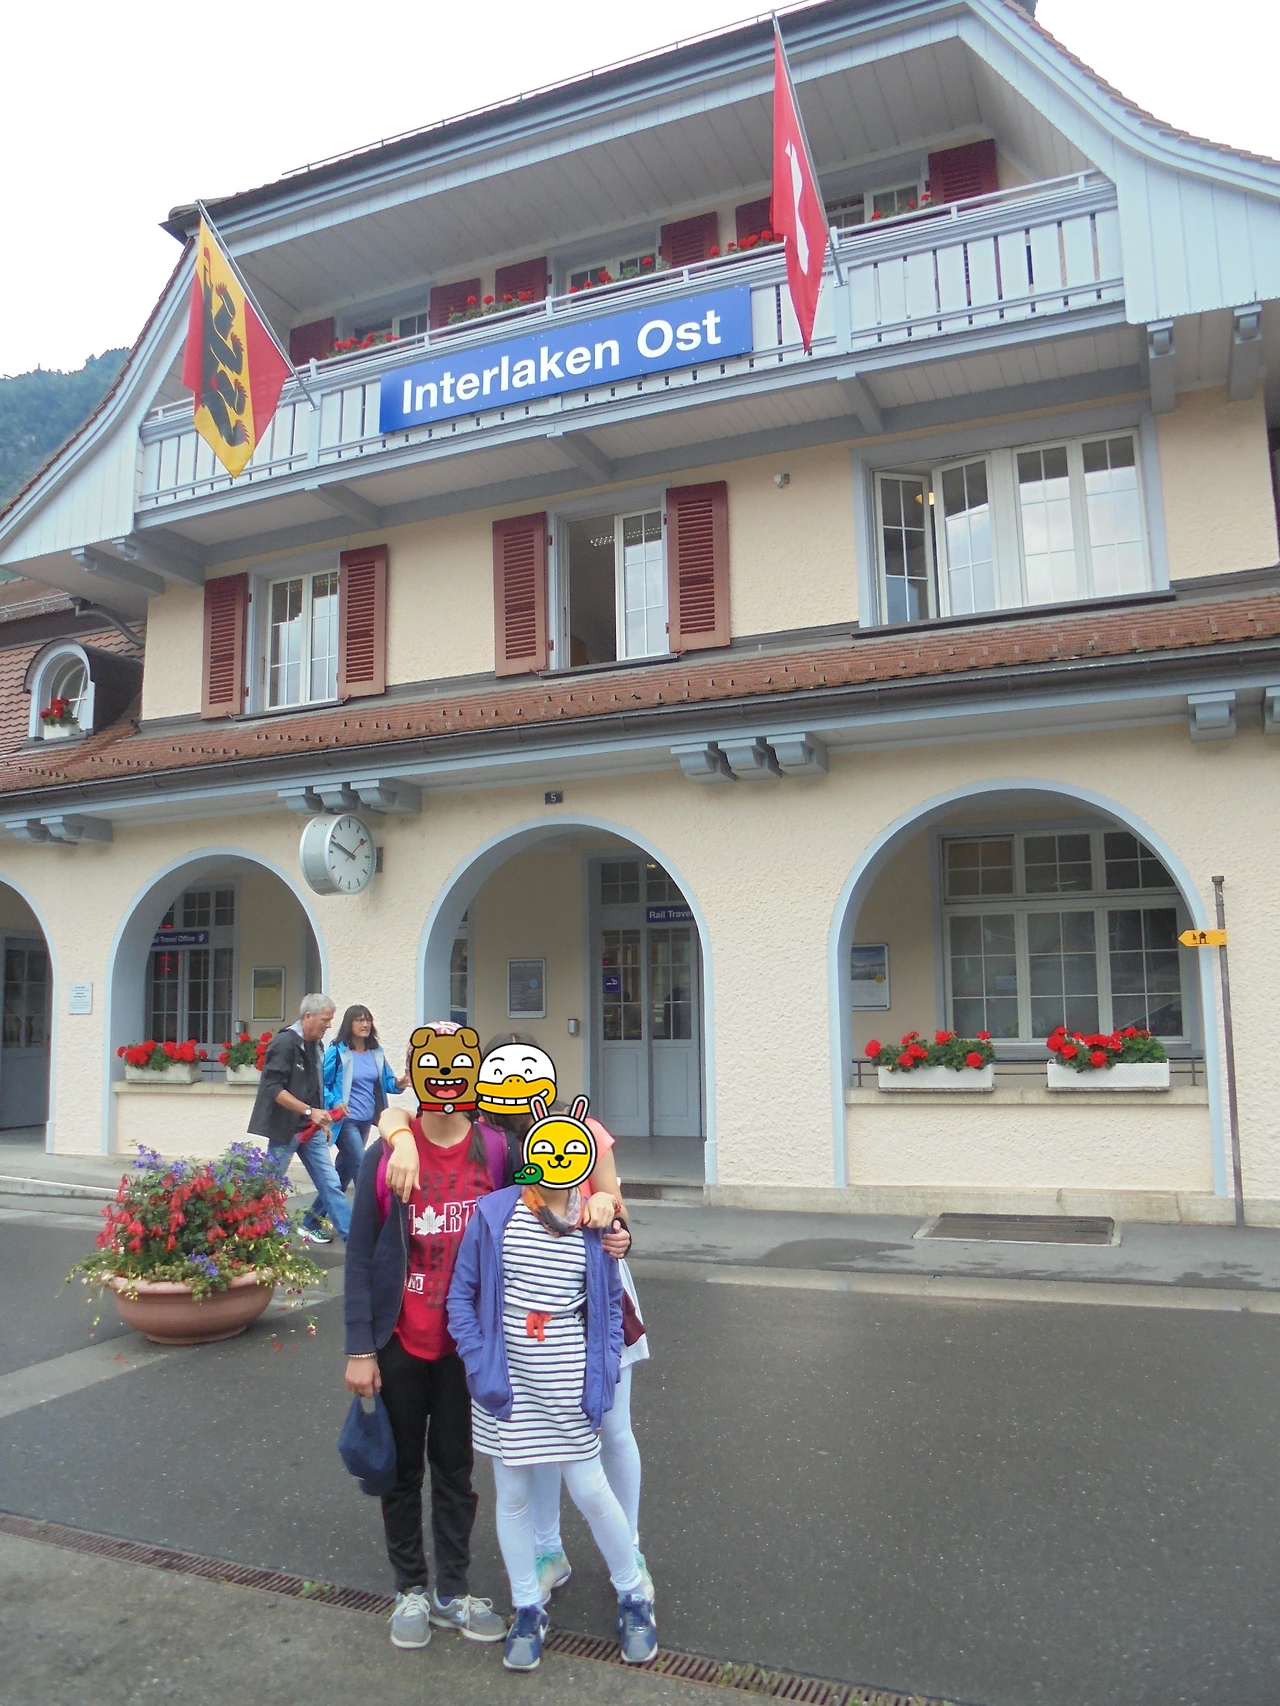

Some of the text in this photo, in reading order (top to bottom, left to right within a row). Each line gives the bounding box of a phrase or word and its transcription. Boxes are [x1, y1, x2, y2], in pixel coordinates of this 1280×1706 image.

[402, 309, 722, 414] Interlaken Ost
[550, 794, 557, 803] 5
[649, 910, 666, 918] Rail
